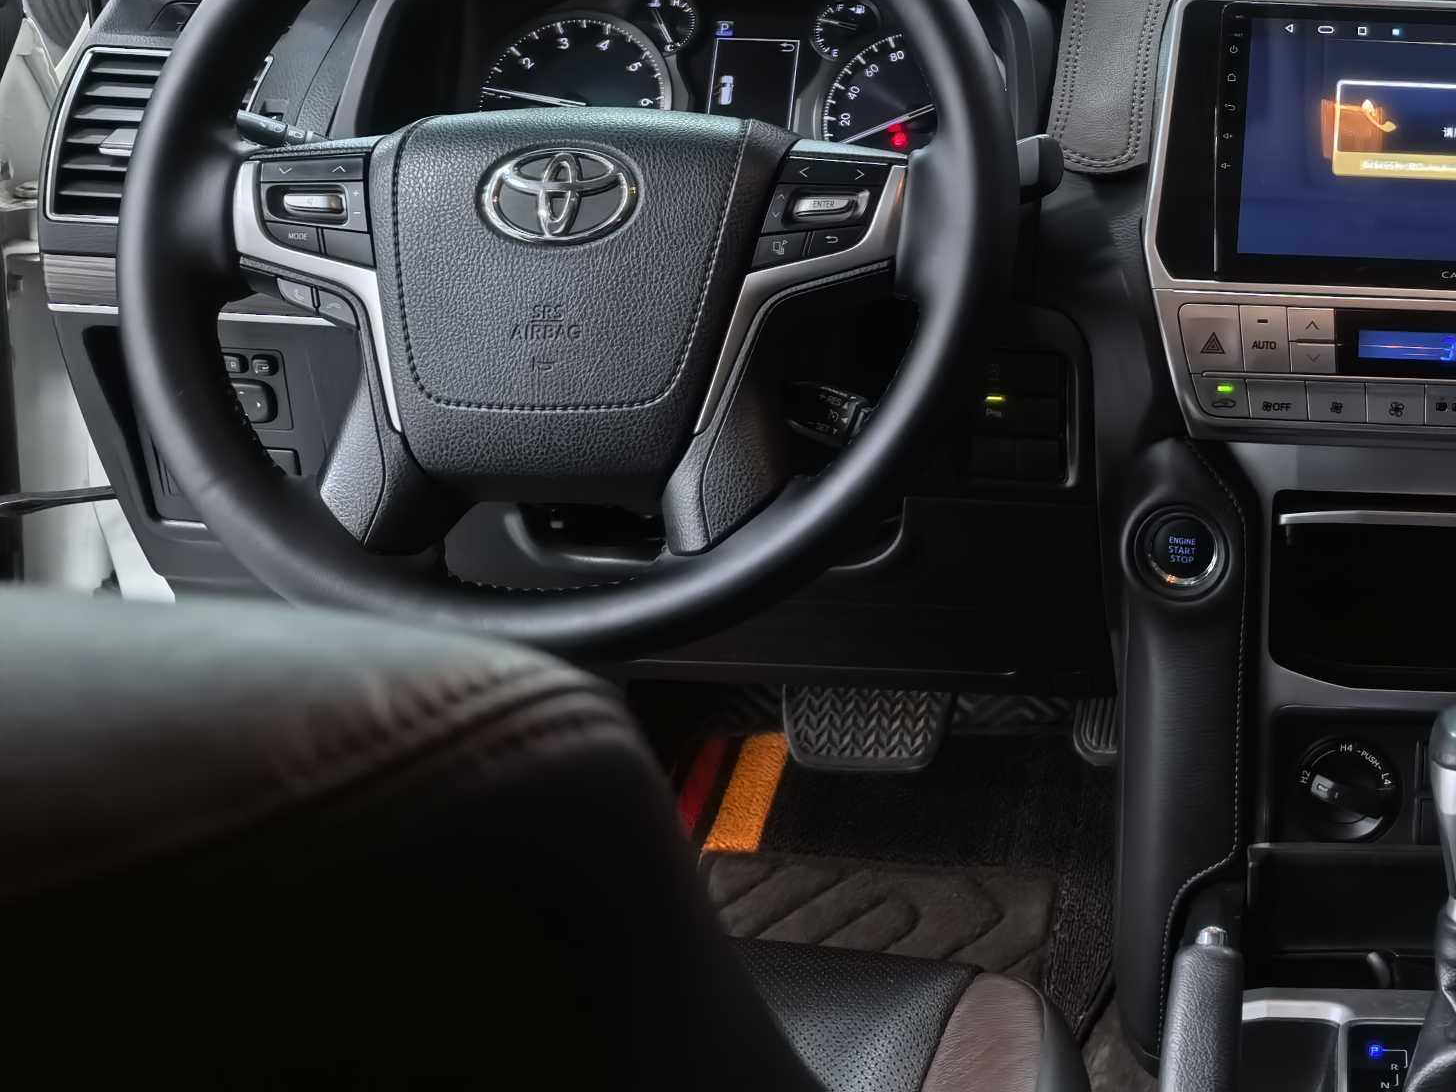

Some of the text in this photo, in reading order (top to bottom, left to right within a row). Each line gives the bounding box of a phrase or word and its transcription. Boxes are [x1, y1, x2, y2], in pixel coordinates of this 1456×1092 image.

[556, 37, 570, 50] 3
[597, 39, 611, 51] 4
[889, 50, 905, 63] 80
[521, 57, 536, 70] 2
[864, 63, 880, 77] 60
[848, 85, 861, 101] 40
[839, 112, 852, 127] 20
[812, 200, 836, 209] ENTER
[288, 231, 309, 241] MODE
[532, 304, 564, 319] SRS
[510, 324, 582, 341] AIRBAG
[1251, 340, 1277, 351] AUTO
[1273, 402, 1292, 412] OFF
[1168, 535, 1197, 546] ENGINE
[1168, 545, 1196, 555] START
[1169, 555, 1194, 564] STOP
[1340, 743, 1353, 753] H4
[1361, 750, 1380, 768] PUSH
[1300, 770, 1311, 784] H2
[1381, 772, 1392, 785] L4
[1391, 1063, 1400, 1071] R
[1380, 1081, 1390, 1089] N
